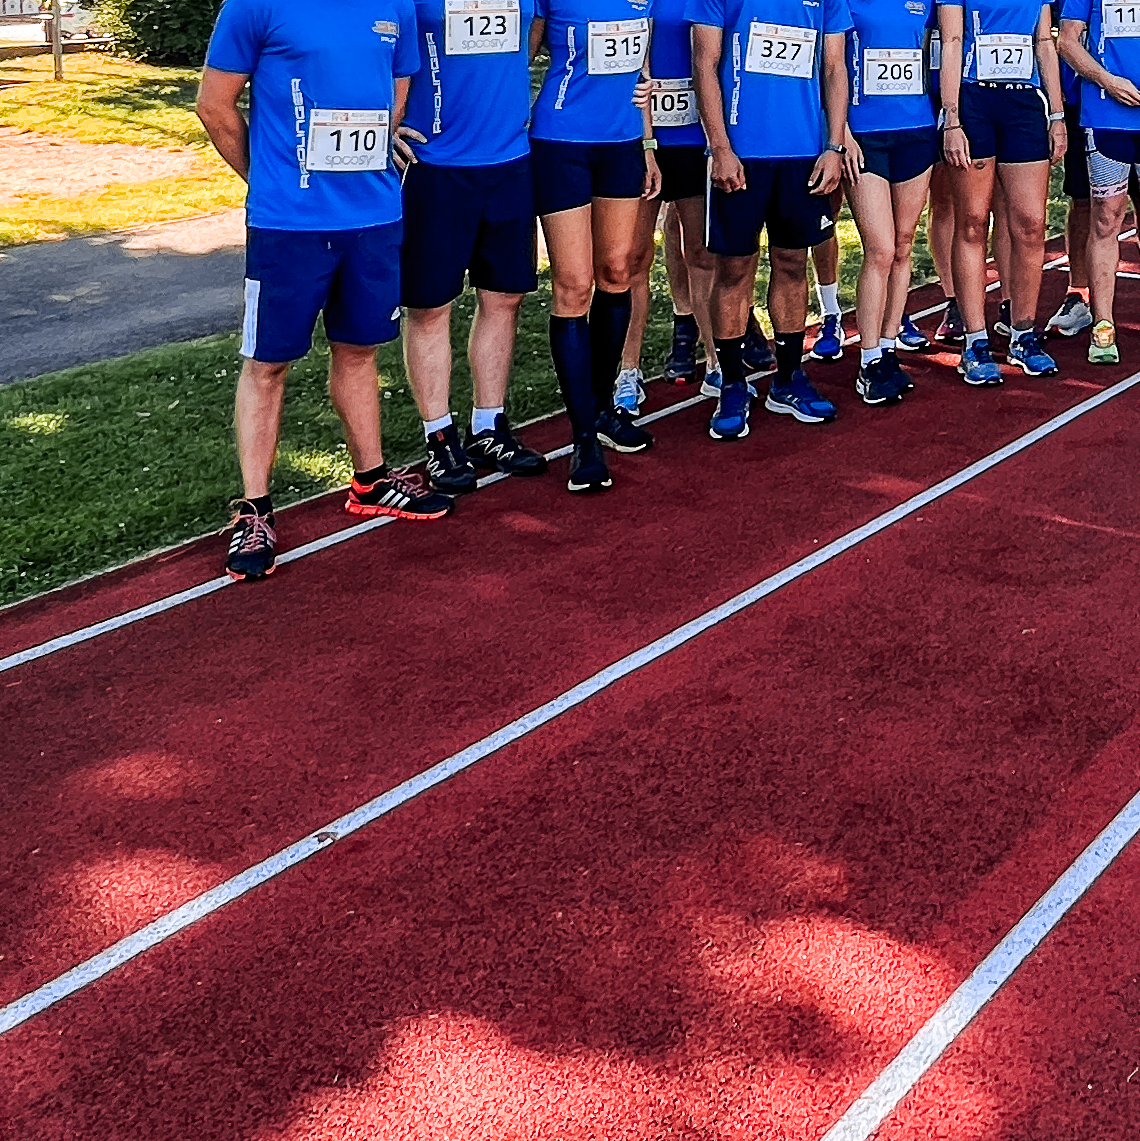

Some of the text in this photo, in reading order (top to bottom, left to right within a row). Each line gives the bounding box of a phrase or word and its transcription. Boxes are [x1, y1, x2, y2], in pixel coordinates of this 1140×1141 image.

[463, 15, 507, 36] 123
[604, 35, 641, 57] 315
[760, 39, 802, 61] 327
[990, 48, 1024, 65] 127
[877, 63, 913, 80] 206
[651, 93, 689, 112] 105
[329, 129, 377, 152] 110
